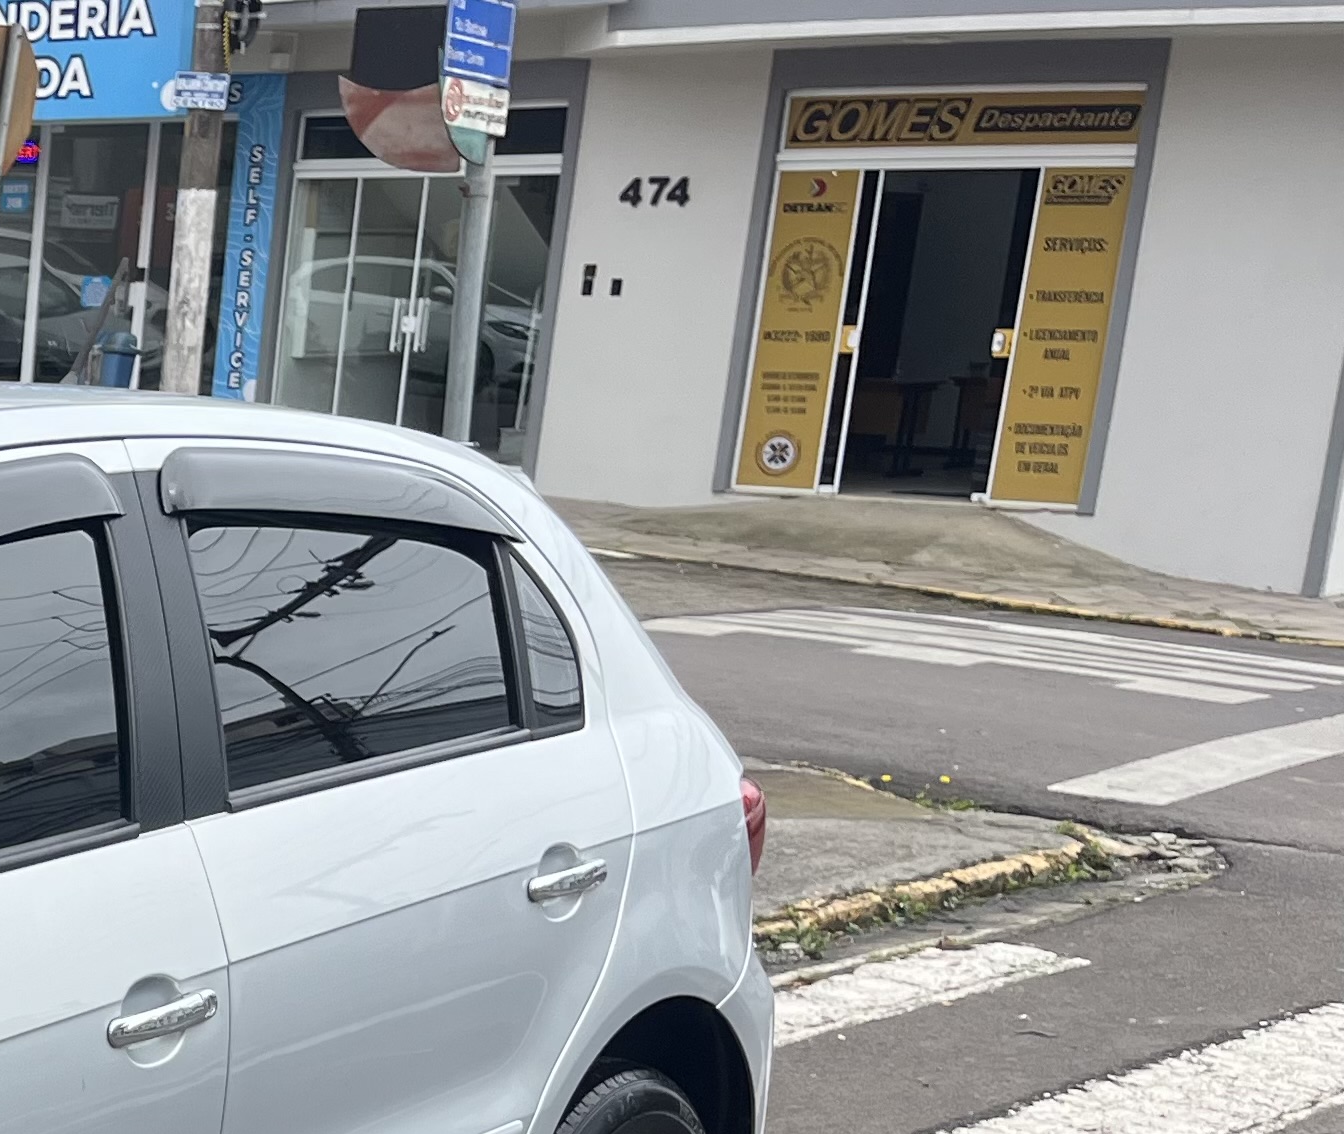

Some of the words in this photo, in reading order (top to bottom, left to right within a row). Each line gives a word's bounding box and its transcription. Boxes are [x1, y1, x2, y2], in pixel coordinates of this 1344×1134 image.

[795, 98, 969, 142] GOMES
[980, 105, 1133, 130] Despachante
[620, 177, 689, 206] 474
